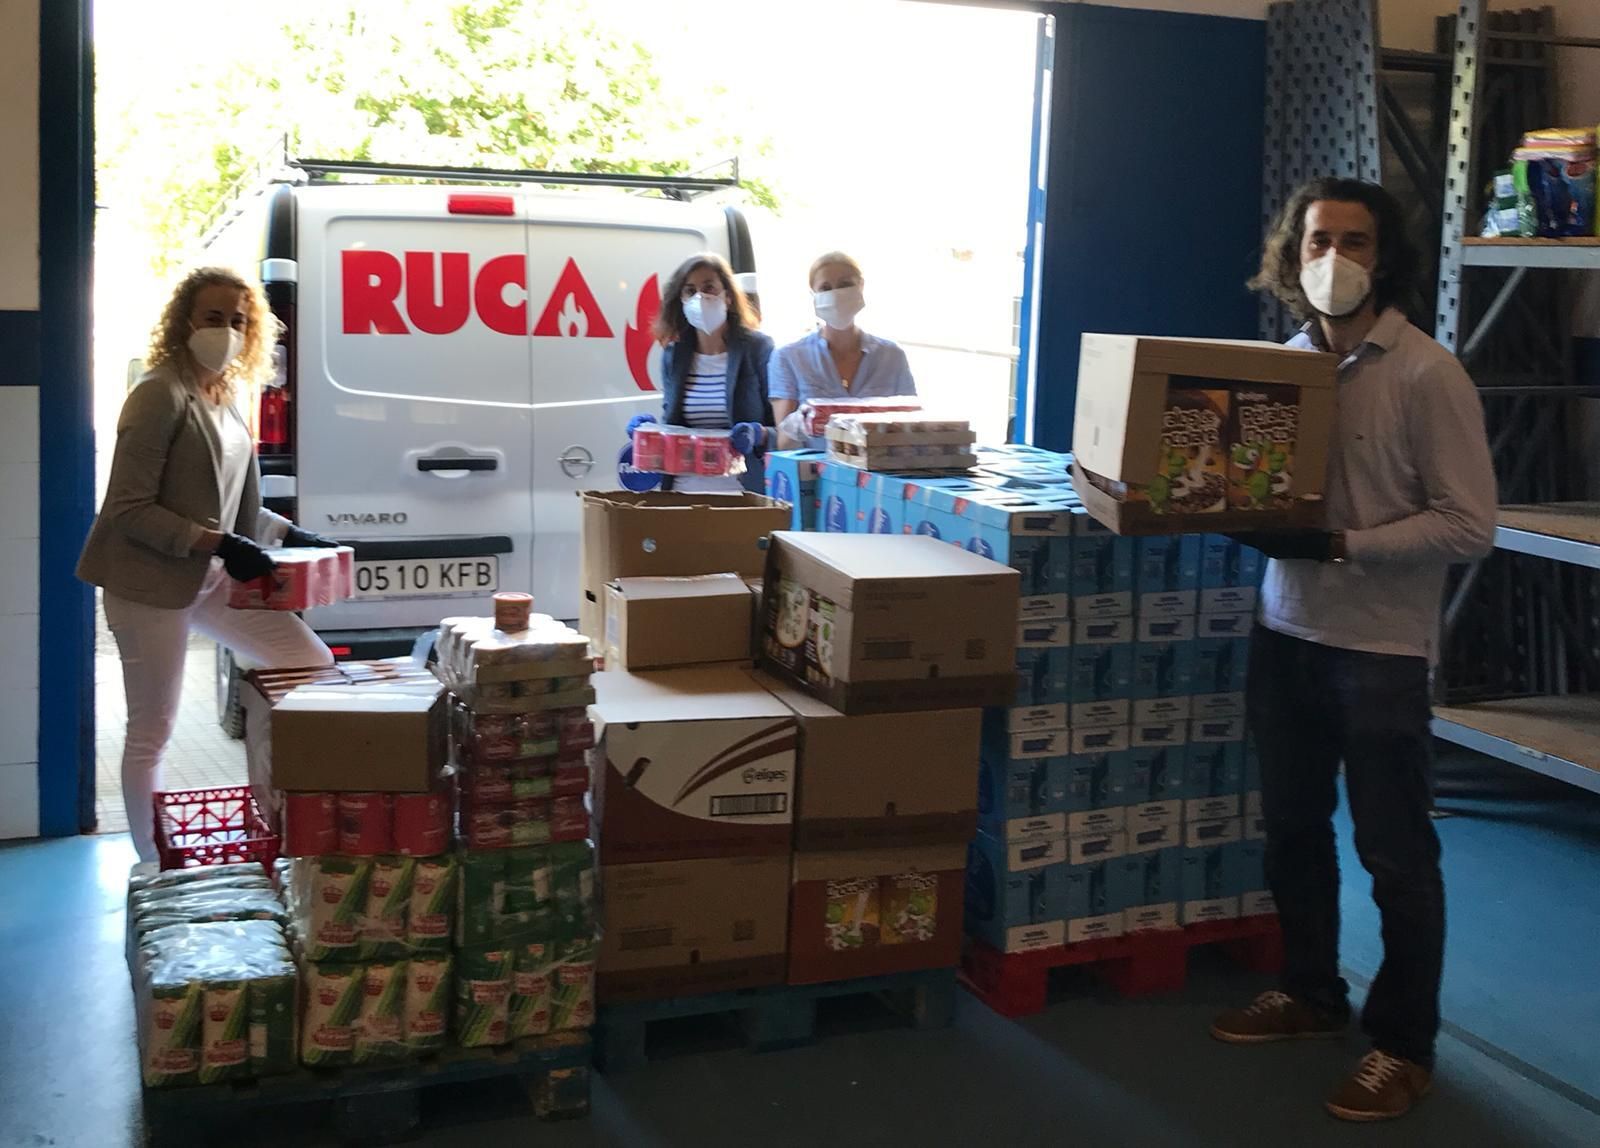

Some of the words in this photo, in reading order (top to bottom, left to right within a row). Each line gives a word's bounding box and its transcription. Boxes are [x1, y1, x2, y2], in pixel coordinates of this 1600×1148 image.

[341, 249, 615, 338] RUCA
[327, 512, 408, 525] VIVARO
[356, 564, 429, 592] 0510
[440, 562, 491, 588] KFB
